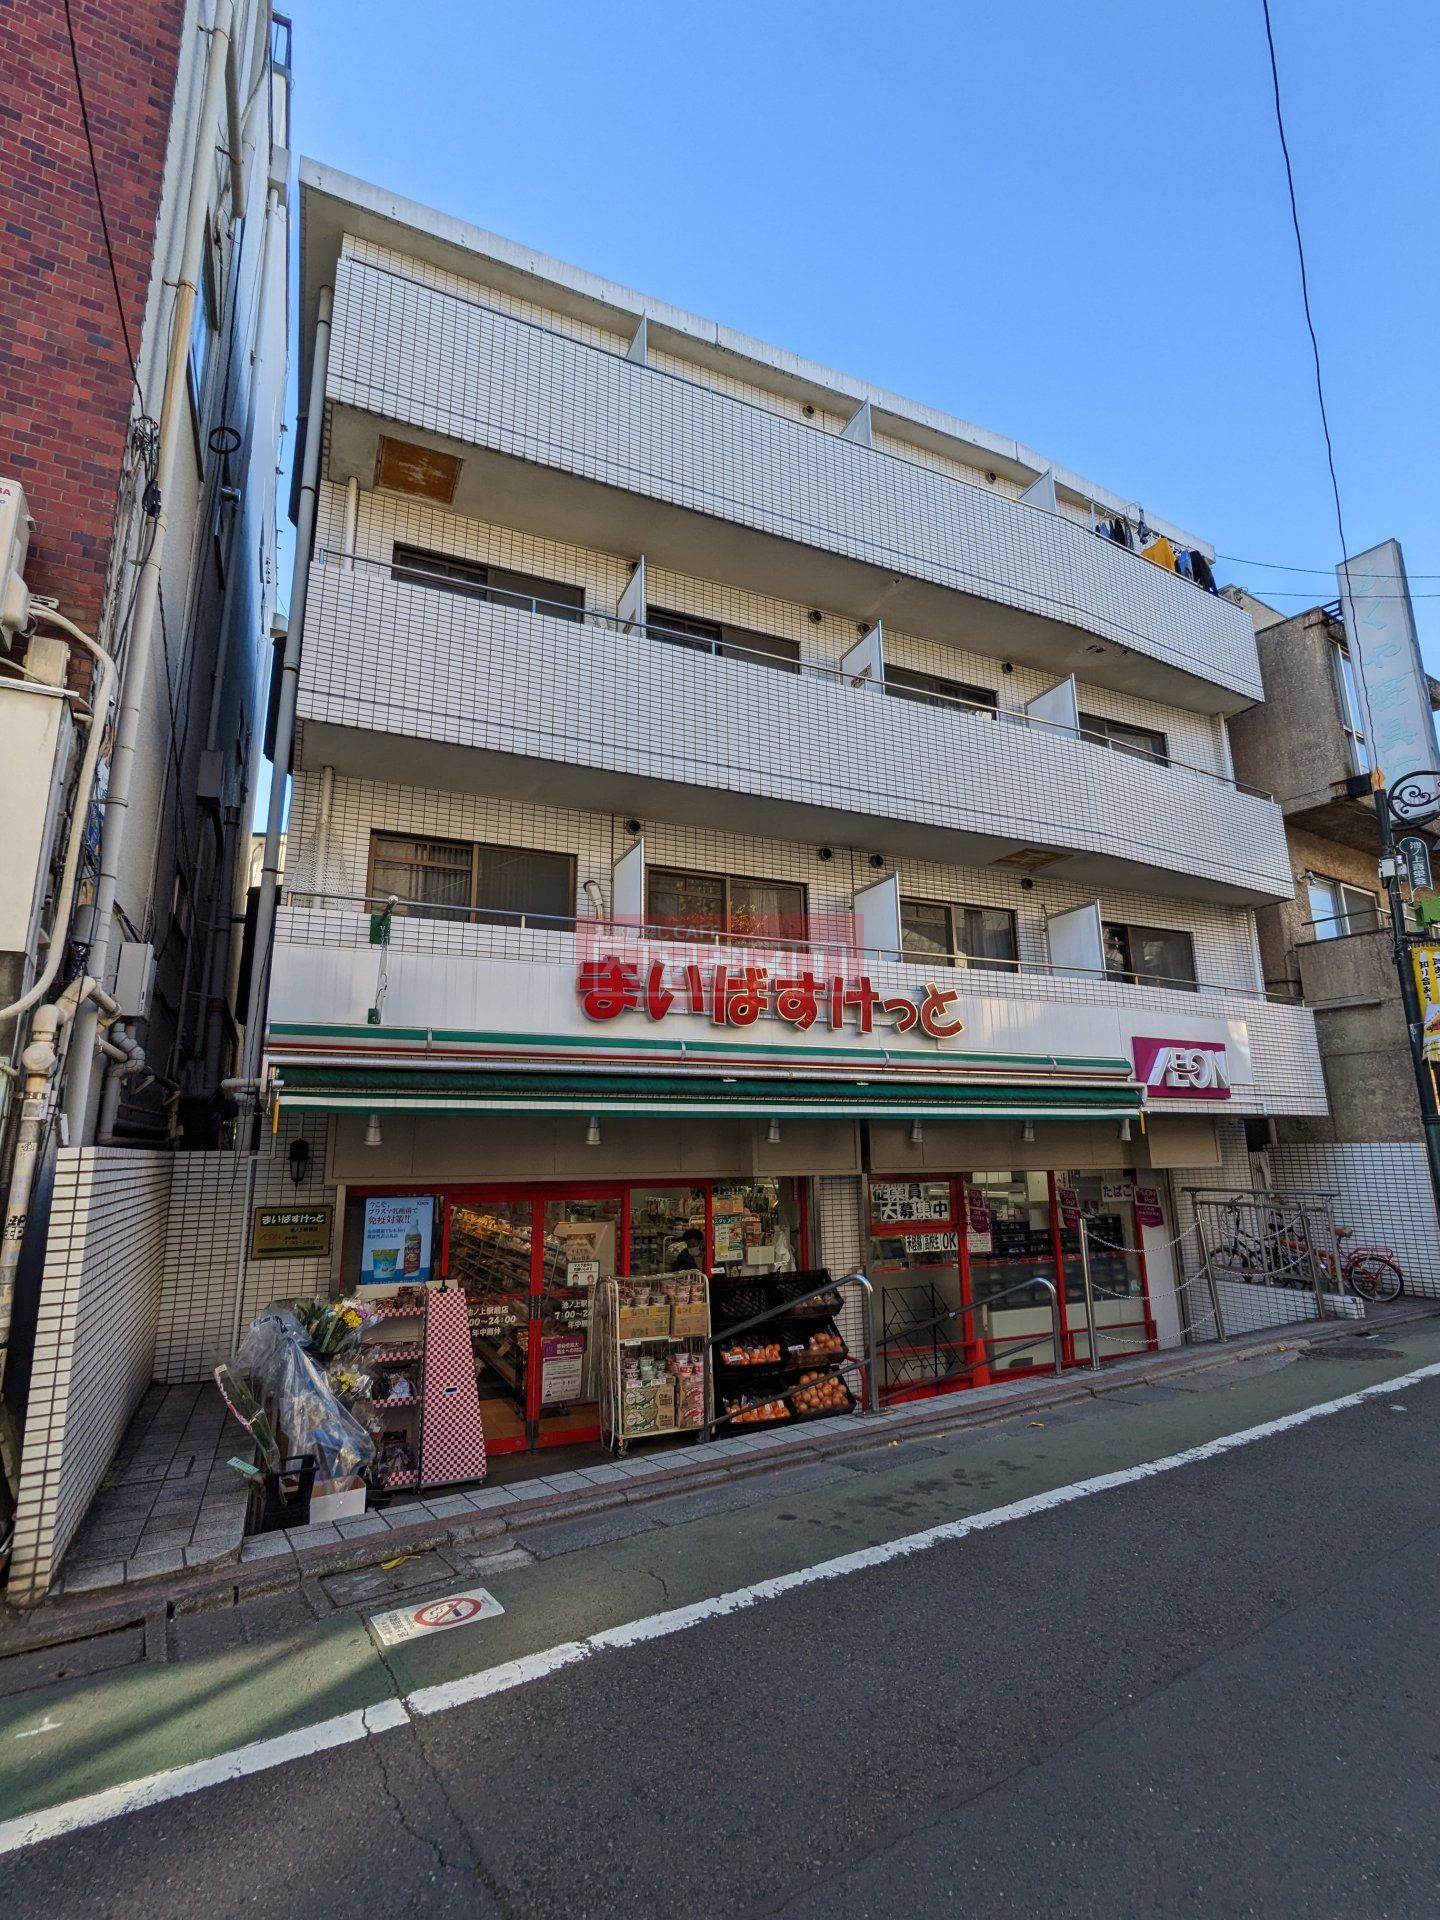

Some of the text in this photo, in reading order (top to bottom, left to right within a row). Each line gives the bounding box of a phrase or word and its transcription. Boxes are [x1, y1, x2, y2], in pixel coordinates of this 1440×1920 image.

[1419, 961, 1431, 1002] 知り合おう
[577, 955, 965, 1039] まいばすけっと
[1146, 1046, 1230, 1089] AEON
[873, 1183, 922, 1201] 従業員
[1103, 1184, 1132, 1198] たばこ
[881, 1201, 948, 1219] 大募集中
[262, 1214, 325, 1225] まいばすけっと
